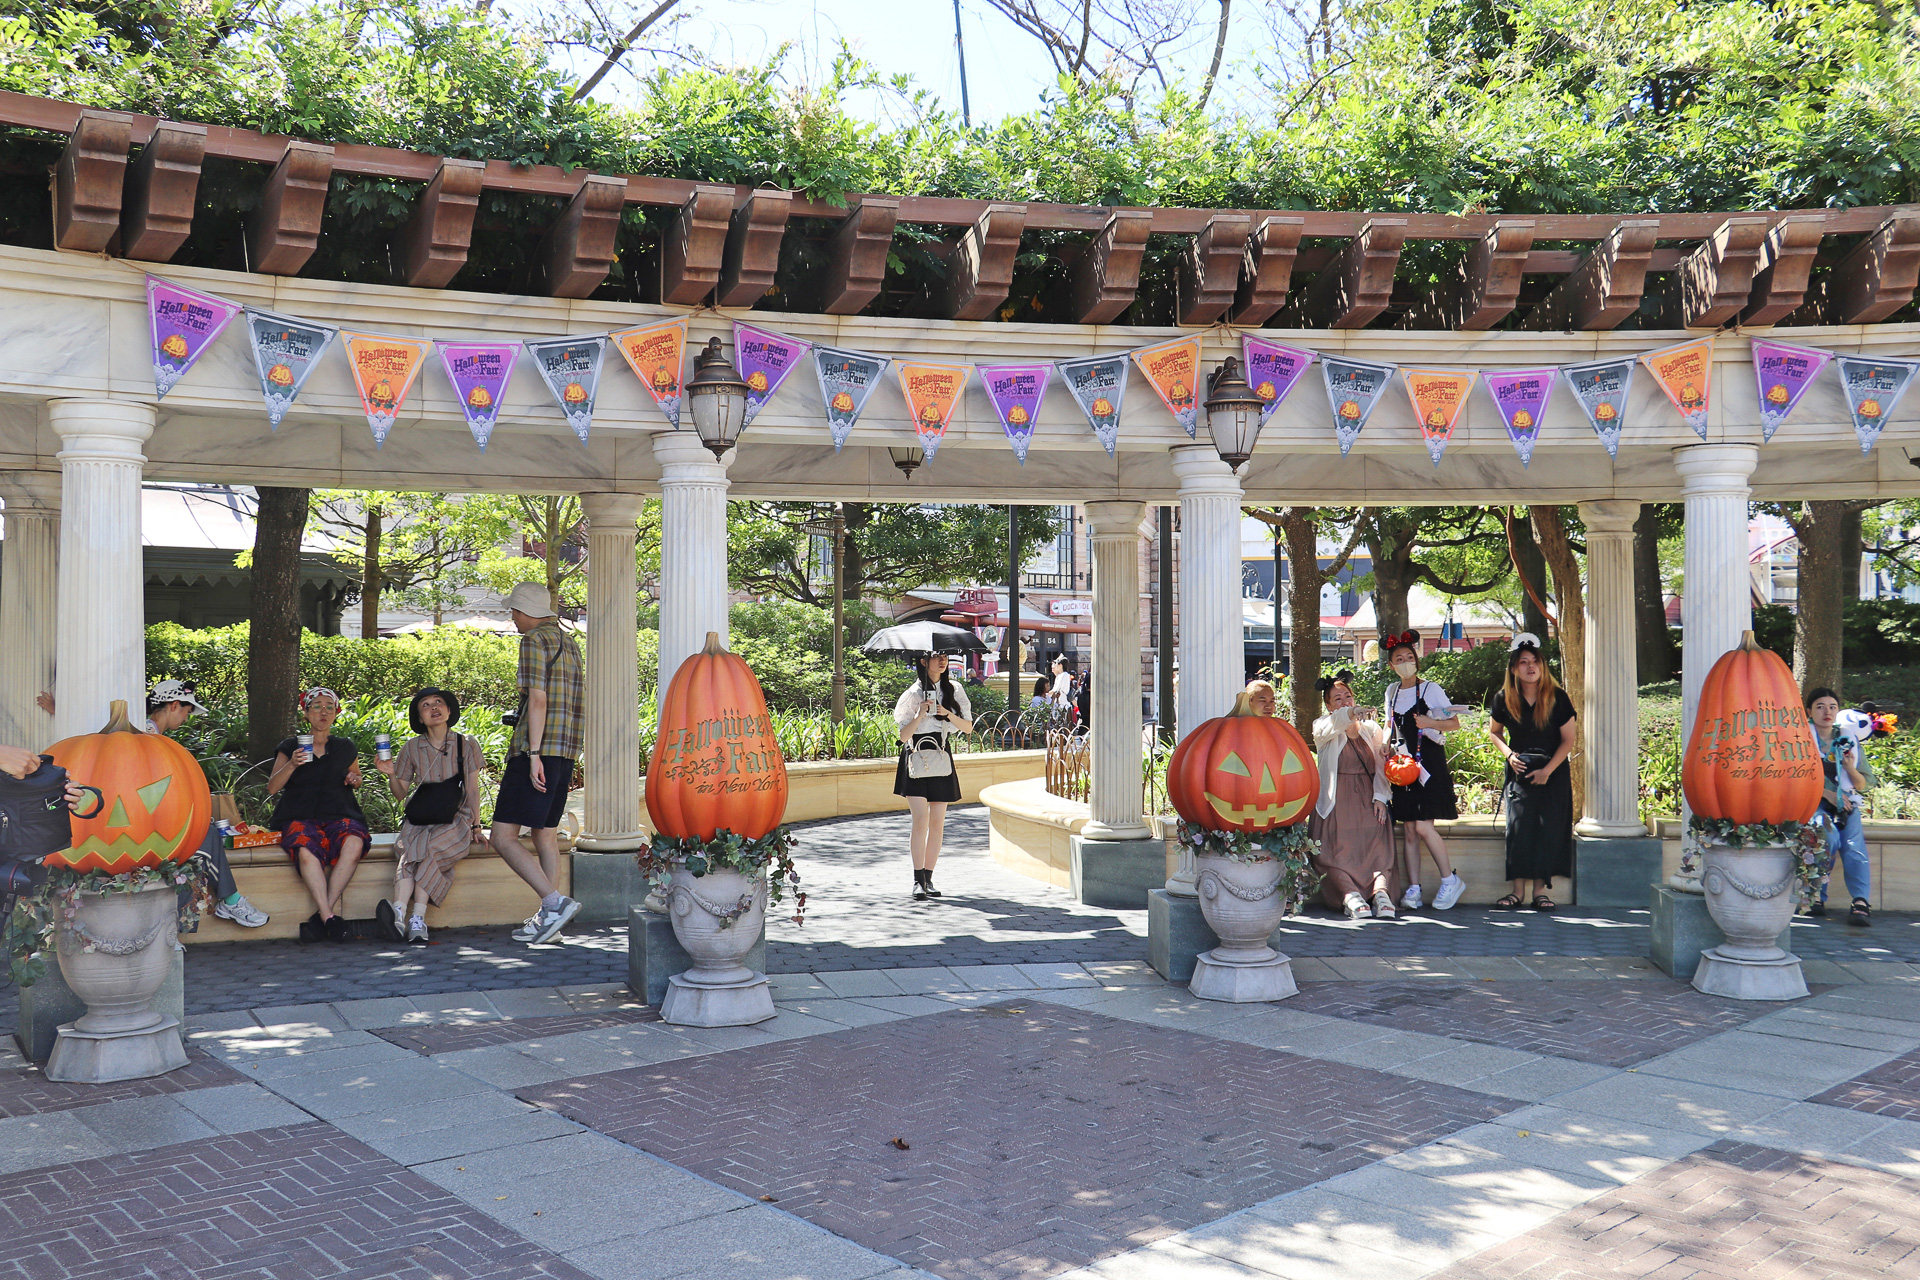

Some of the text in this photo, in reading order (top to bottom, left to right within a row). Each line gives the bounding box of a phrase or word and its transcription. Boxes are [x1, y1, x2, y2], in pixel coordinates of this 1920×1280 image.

[157, 300, 214, 320] Halloween
[186, 314, 208, 331] Fair
[259, 331, 312, 345] Halloween
[287, 342, 309, 357] Fair
[631, 333, 673, 359] Halloween
[656, 345, 674, 356] Fair
[743, 340, 789, 357] Halloween
[357, 348, 408, 365] Halloween
[453, 354, 501, 373] Halloween
[545, 349, 590, 371] Halloween
[765, 352, 784, 367] Fair
[1150, 349, 1188, 376] Halloween
[1251, 353, 1295, 367] Halloween
[1761, 356, 1809, 369] Halloween
[384, 357, 406, 372] Fair
[479, 363, 500, 376] Fair
[571, 360, 590, 371] Fair
[824, 363, 869, 376] Halloween
[1173, 360, 1190, 372] Fair
[1272, 363, 1291, 376] Fair
[1660, 352, 1700, 378] Halloween
[1683, 362, 1700, 374] Fair
[1784, 365, 1803, 378] Fair
[848, 371, 866, 385] Fair
[910, 373, 953, 390] Halloween
[994, 375, 1035, 394] Halloween
[1074, 365, 1115, 389] Halloween
[1098, 375, 1115, 387] Fair
[1331, 372, 1375, 385] Halloween
[1578, 370, 1620, 393] Halloween
[1849, 370, 1897, 385] Halloween
[1874, 379, 1893, 390] Fair
[933, 382, 951, 395] Fair
[1016, 384, 1035, 395] Fair
[1354, 380, 1372, 393] Fair
[1415, 380, 1458, 396] Halloween
[1498, 380, 1540, 399] Halloween
[1602, 380, 1619, 392] Fair
[1438, 389, 1457, 400] Fair
[1521, 389, 1539, 400] Fair
[1697, 706, 1808, 751] Halloween
[662, 713, 771, 765] Halloween
[1760, 730, 1811, 763] Fair
[726, 741, 776, 776] Fair
[1730, 763, 1817, 781] in New York
[695, 774, 782, 795] in New York
